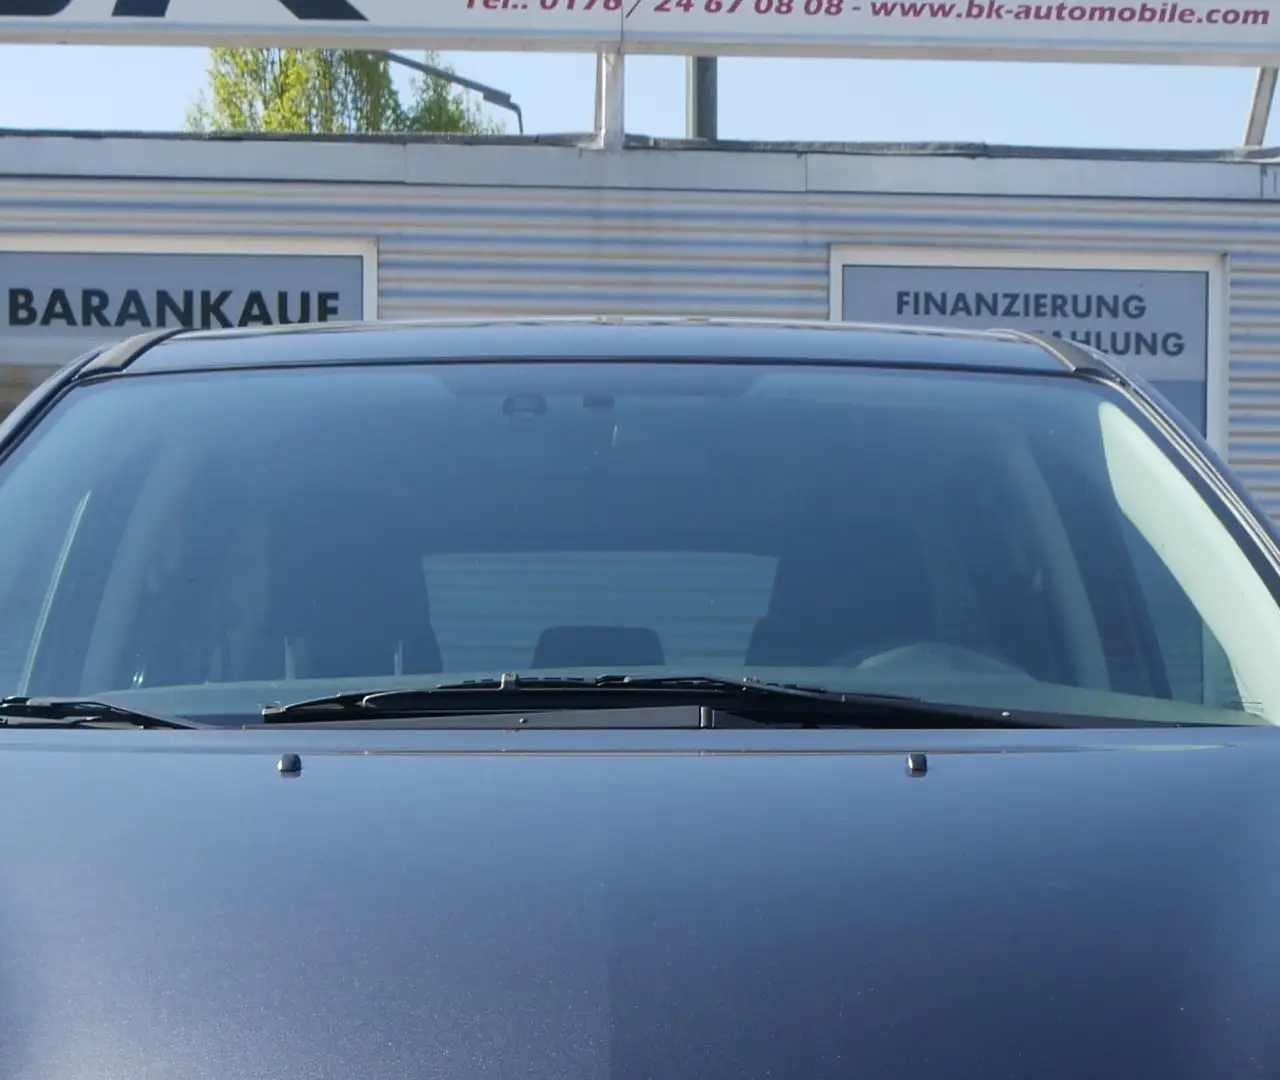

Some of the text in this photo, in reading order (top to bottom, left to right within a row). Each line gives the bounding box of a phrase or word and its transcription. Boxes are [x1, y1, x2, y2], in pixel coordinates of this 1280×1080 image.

[754, 0, 794, 15] 08
[803, 0, 845, 17] 08
[870, 0, 1270, 25] www.bk-automobile.com
[7, 288, 340, 327] BARANKAUF
[896, 290, 1146, 319] FINANZIERUNG
